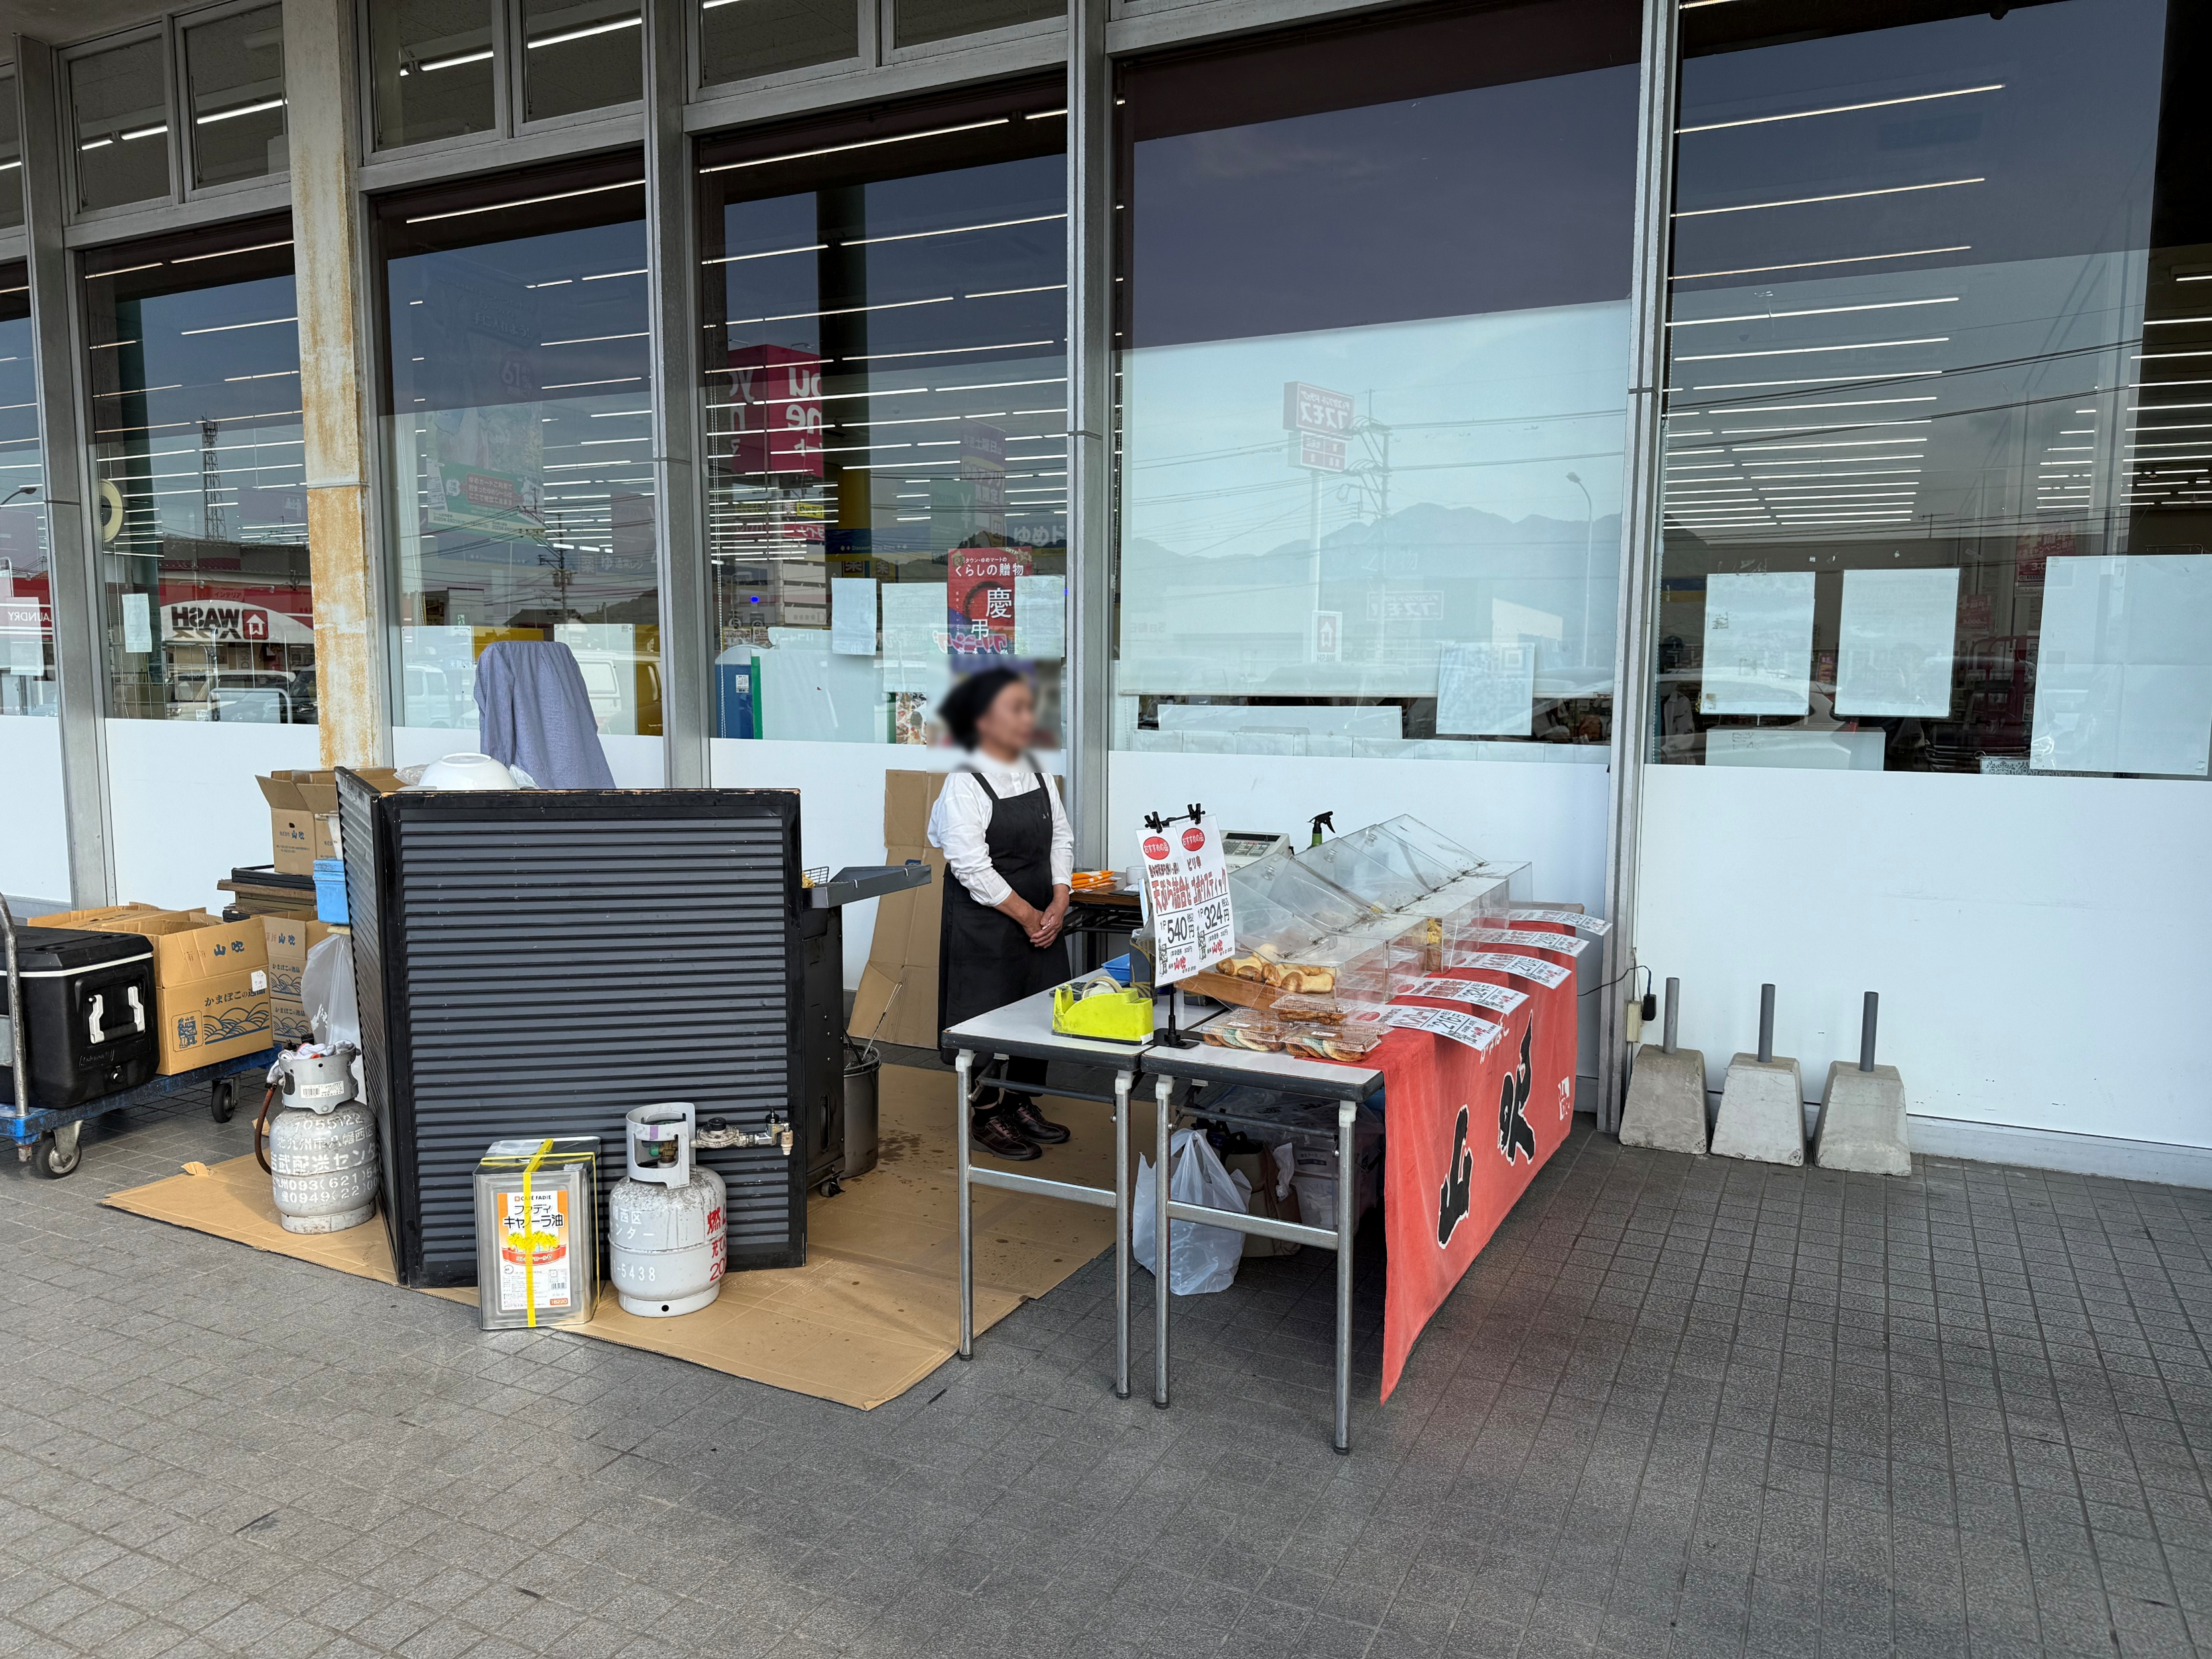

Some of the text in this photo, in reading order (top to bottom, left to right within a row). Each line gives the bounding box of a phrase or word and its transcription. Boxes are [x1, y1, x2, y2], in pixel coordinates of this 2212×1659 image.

[955, 562, 1024, 577] くらしの贈物
[214, 591, 243, 600] インテリア
[985, 587, 1013, 619] 慶
[971, 618, 989, 641] 弔
[291, 830, 305, 841] 山吹
[1182, 832, 1205, 846] おすすめの品
[1144, 842, 1170, 854] おすすめの品
[1186, 855, 1202, 872] ピリ辛
[1150, 875, 1192, 914] 天ぷら詰合せ
[1204, 902, 1223, 930] 324
[1223, 908, 1230, 922] 円
[1167, 916, 1188, 944] 540
[1188, 924, 1195, 940] 円
[278, 932, 296, 946] 山吹
[214, 940, 245, 958] 山吹
[272, 963, 301, 974] かまぼこの逸品
[1432, 1013, 1463, 1030] 216
[294, 1113, 364, 1134] 1055122
[514, 1204, 552, 1215] ファディ
[503, 1214, 563, 1229] キャノーラ油
